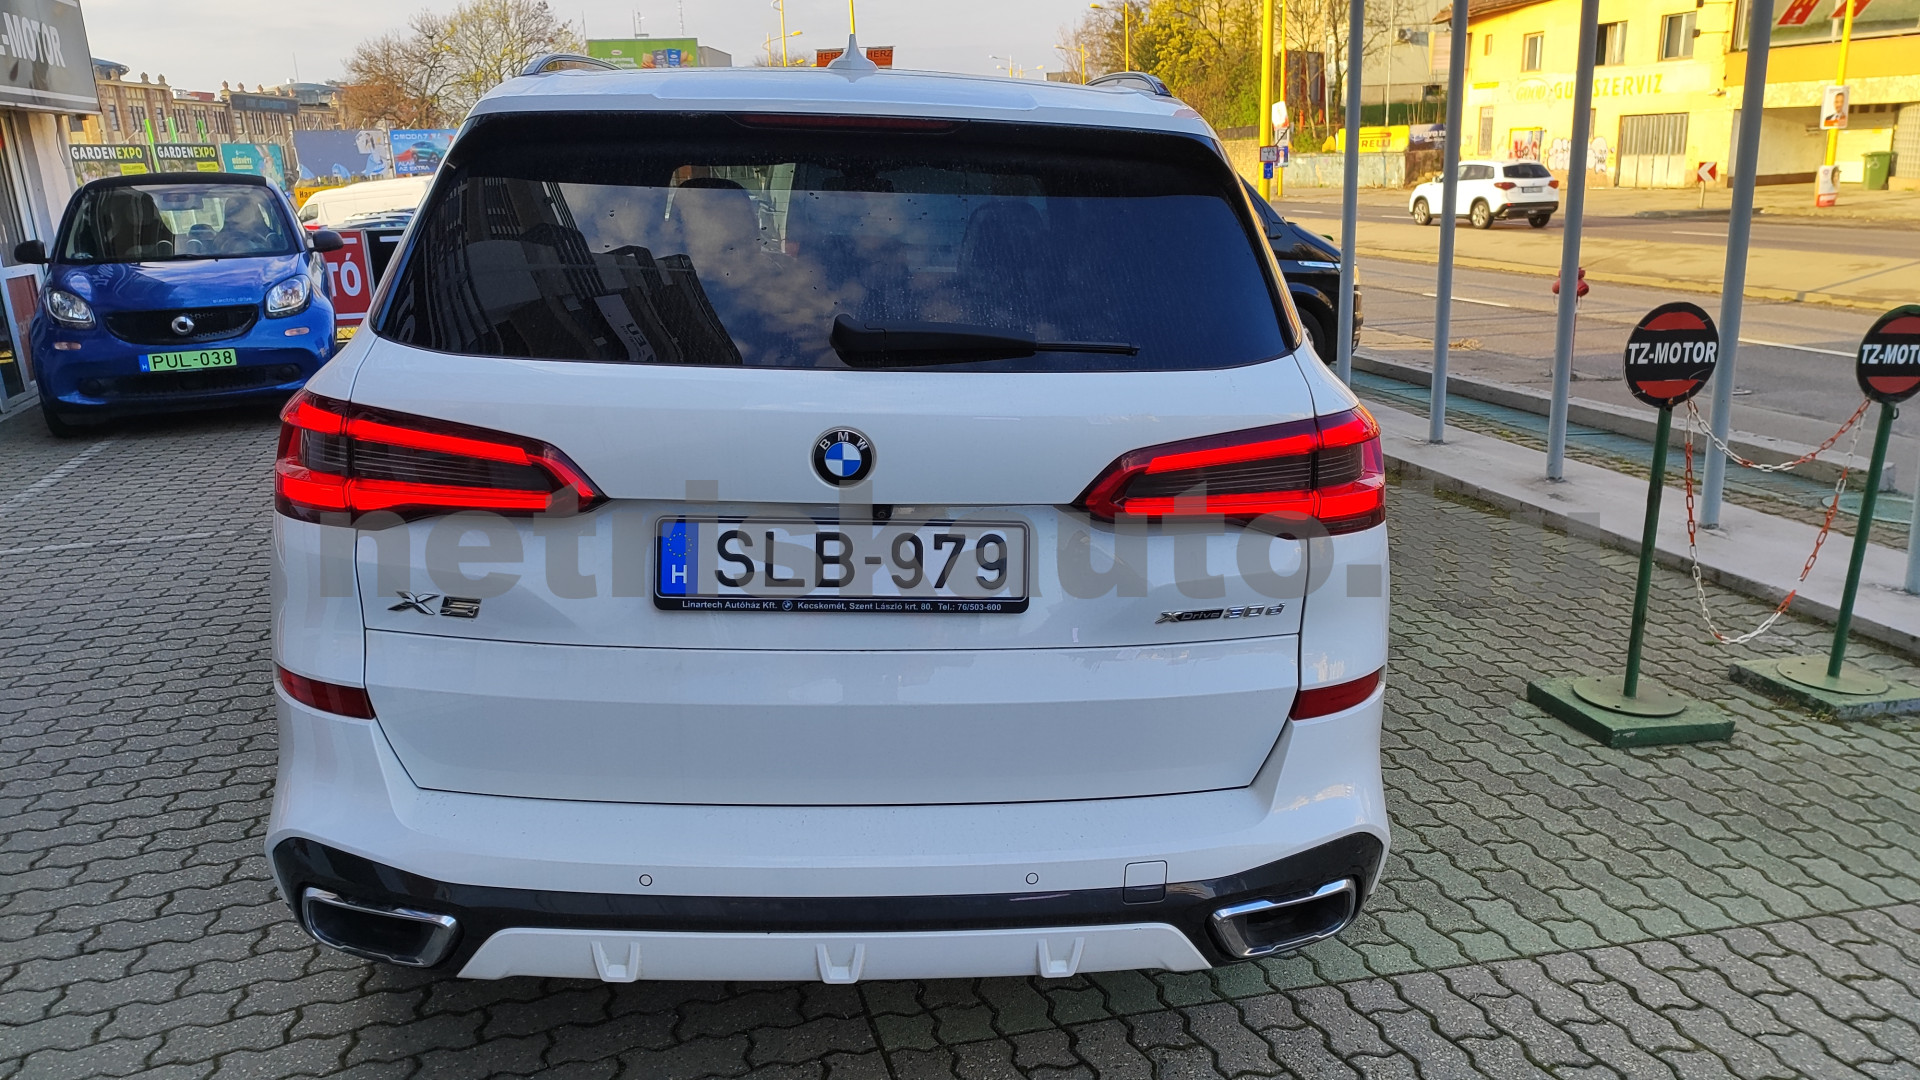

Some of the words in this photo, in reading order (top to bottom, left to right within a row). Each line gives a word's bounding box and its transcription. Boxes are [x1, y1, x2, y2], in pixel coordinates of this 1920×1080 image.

[0, 11, 66, 68] -MOTOR
[1554, 74, 1663, 99] GUSZERVIZ
[1361, 139, 1391, 148] RELLI
[152, 350, 233, 370] PUL-038
[1628, 341, 1717, 365] TZ-MOTOR
[819, 431, 869, 451] BMW
[671, 564, 688, 584] H
[714, 529, 1008, 590] SLB-979
[387, 591, 482, 618] X5
[682, 600, 723, 609] Linartech
[724, 600, 761, 610] Autóház
[762, 601, 778, 610] Kft.
[849, 602, 874, 611] Szent
[875, 602, 902, 611] László
[904, 602, 919, 611] krt.
[920, 603, 933, 611] 80.
[938, 603, 955, 611] Tel.:
[957, 603, 1002, 612] 76/503-600
